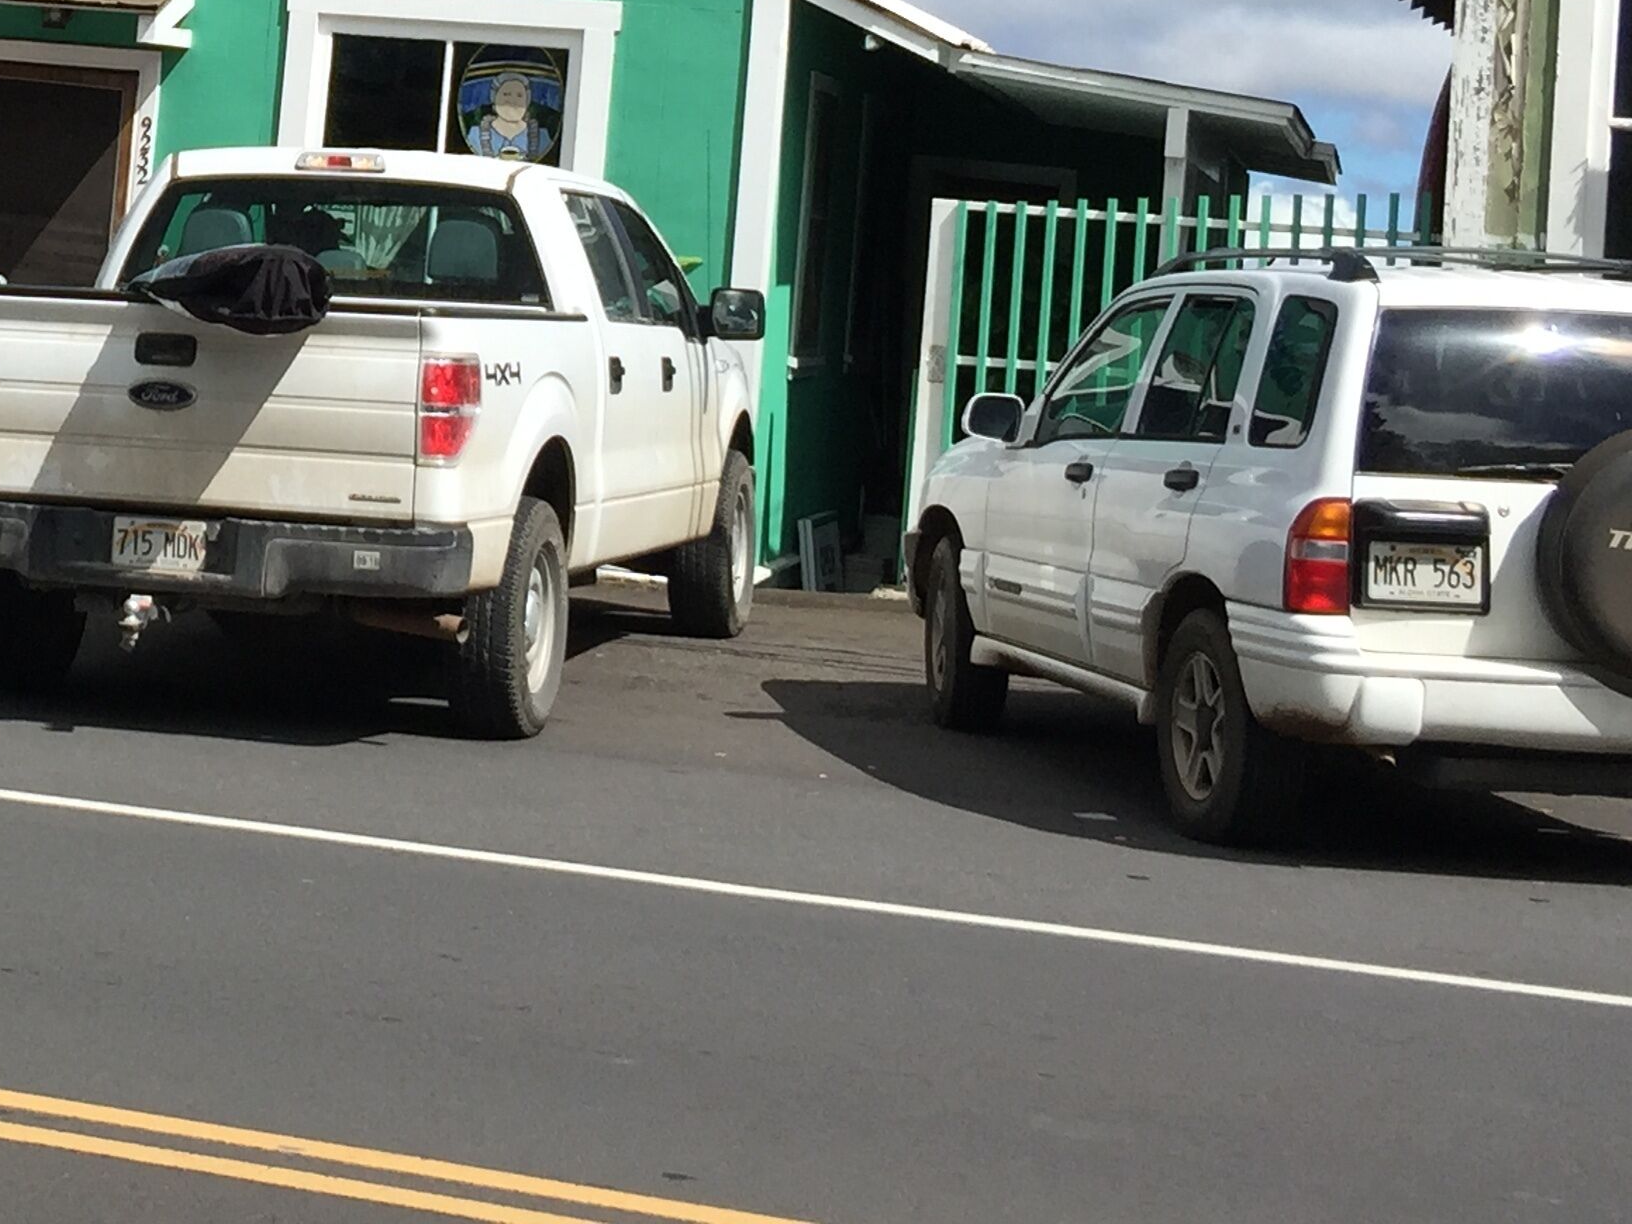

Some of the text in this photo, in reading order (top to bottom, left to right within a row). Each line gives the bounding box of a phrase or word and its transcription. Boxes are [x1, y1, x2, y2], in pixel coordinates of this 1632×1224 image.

[117, 528, 199, 561] 715 MDK
[1373, 555, 1476, 590] MKR 563
